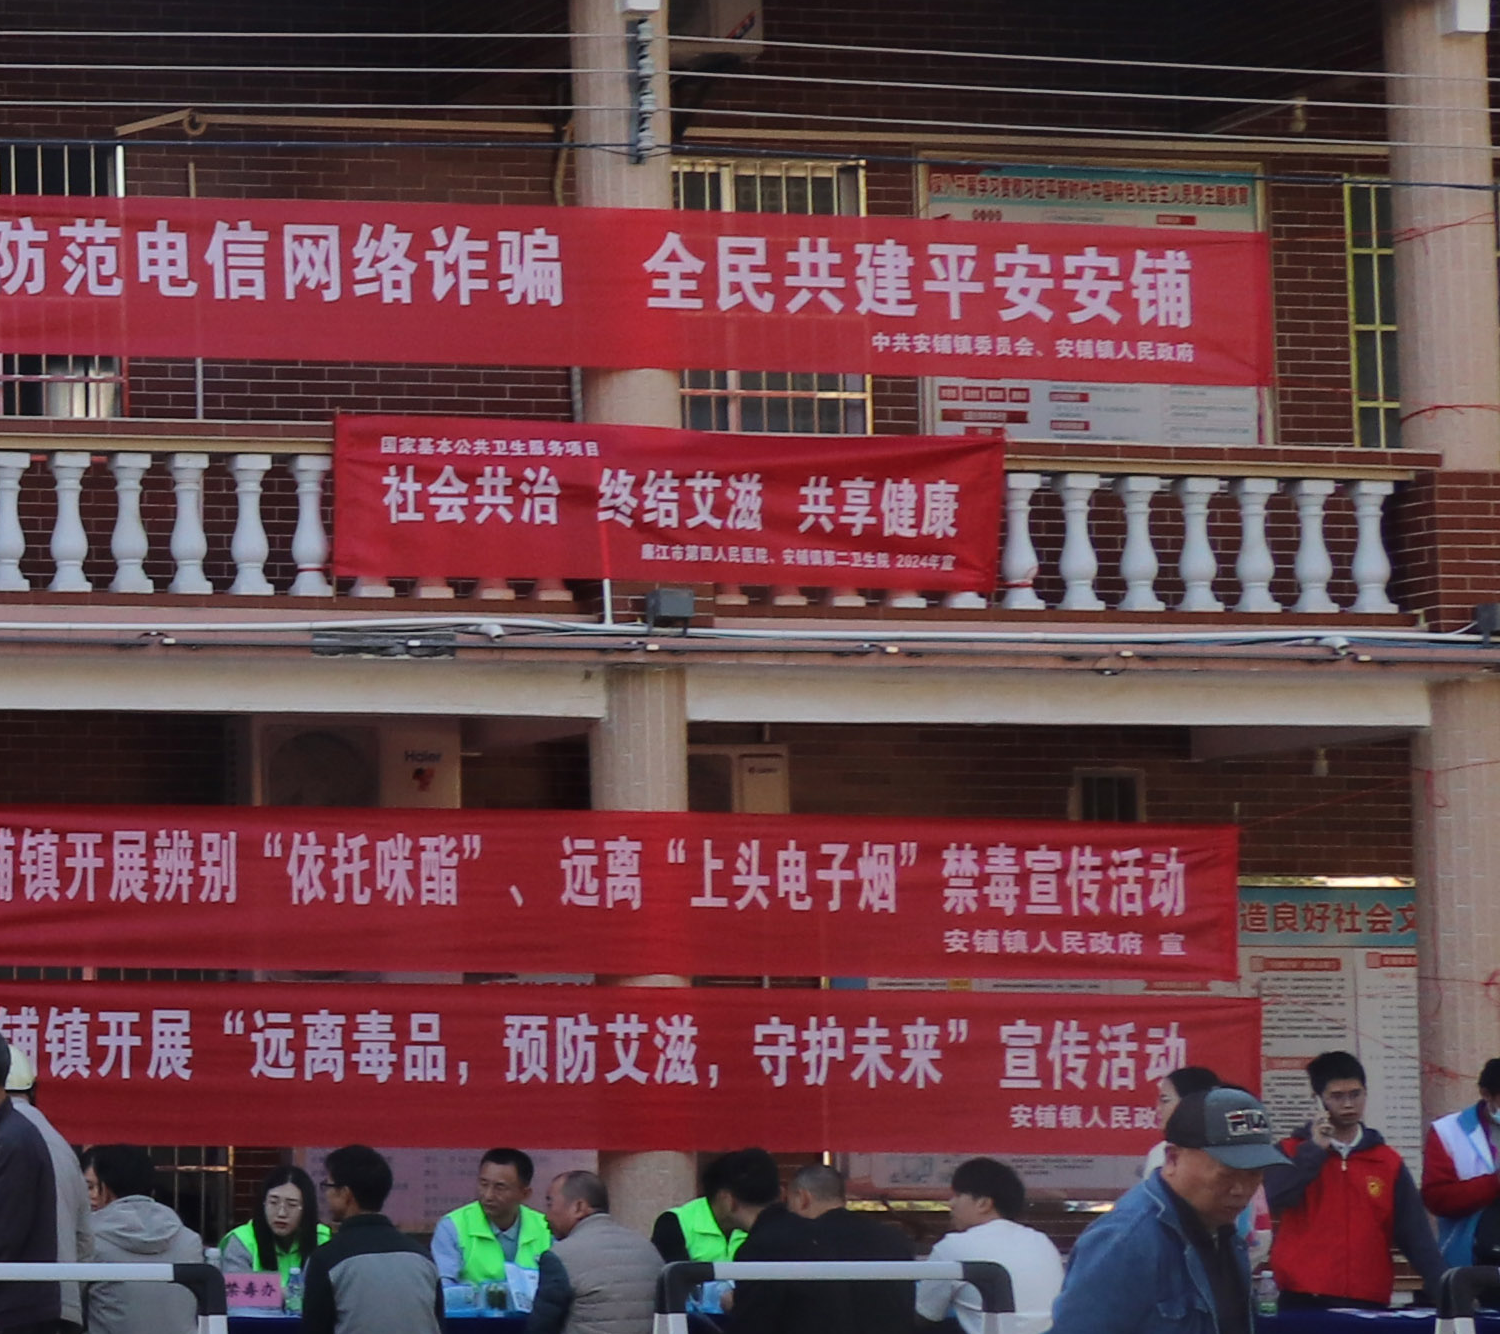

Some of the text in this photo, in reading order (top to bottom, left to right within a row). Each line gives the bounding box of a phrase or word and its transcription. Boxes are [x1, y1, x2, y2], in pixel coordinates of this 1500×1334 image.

[643, 236, 1193, 330] 全民共建平安安铺
[869, 330, 1195, 366] 中共安铺镇委员会、安铺镇人民政府
[380, 435, 600, 458] 国家基本公共卫生服务项目
[382, 464, 959, 539] 社会共治 终结艾滋 共享健康
[944, 930, 1187, 957] 安铺镇人民政府 宣
[226, 1281, 277, 1298] 禁毒办
